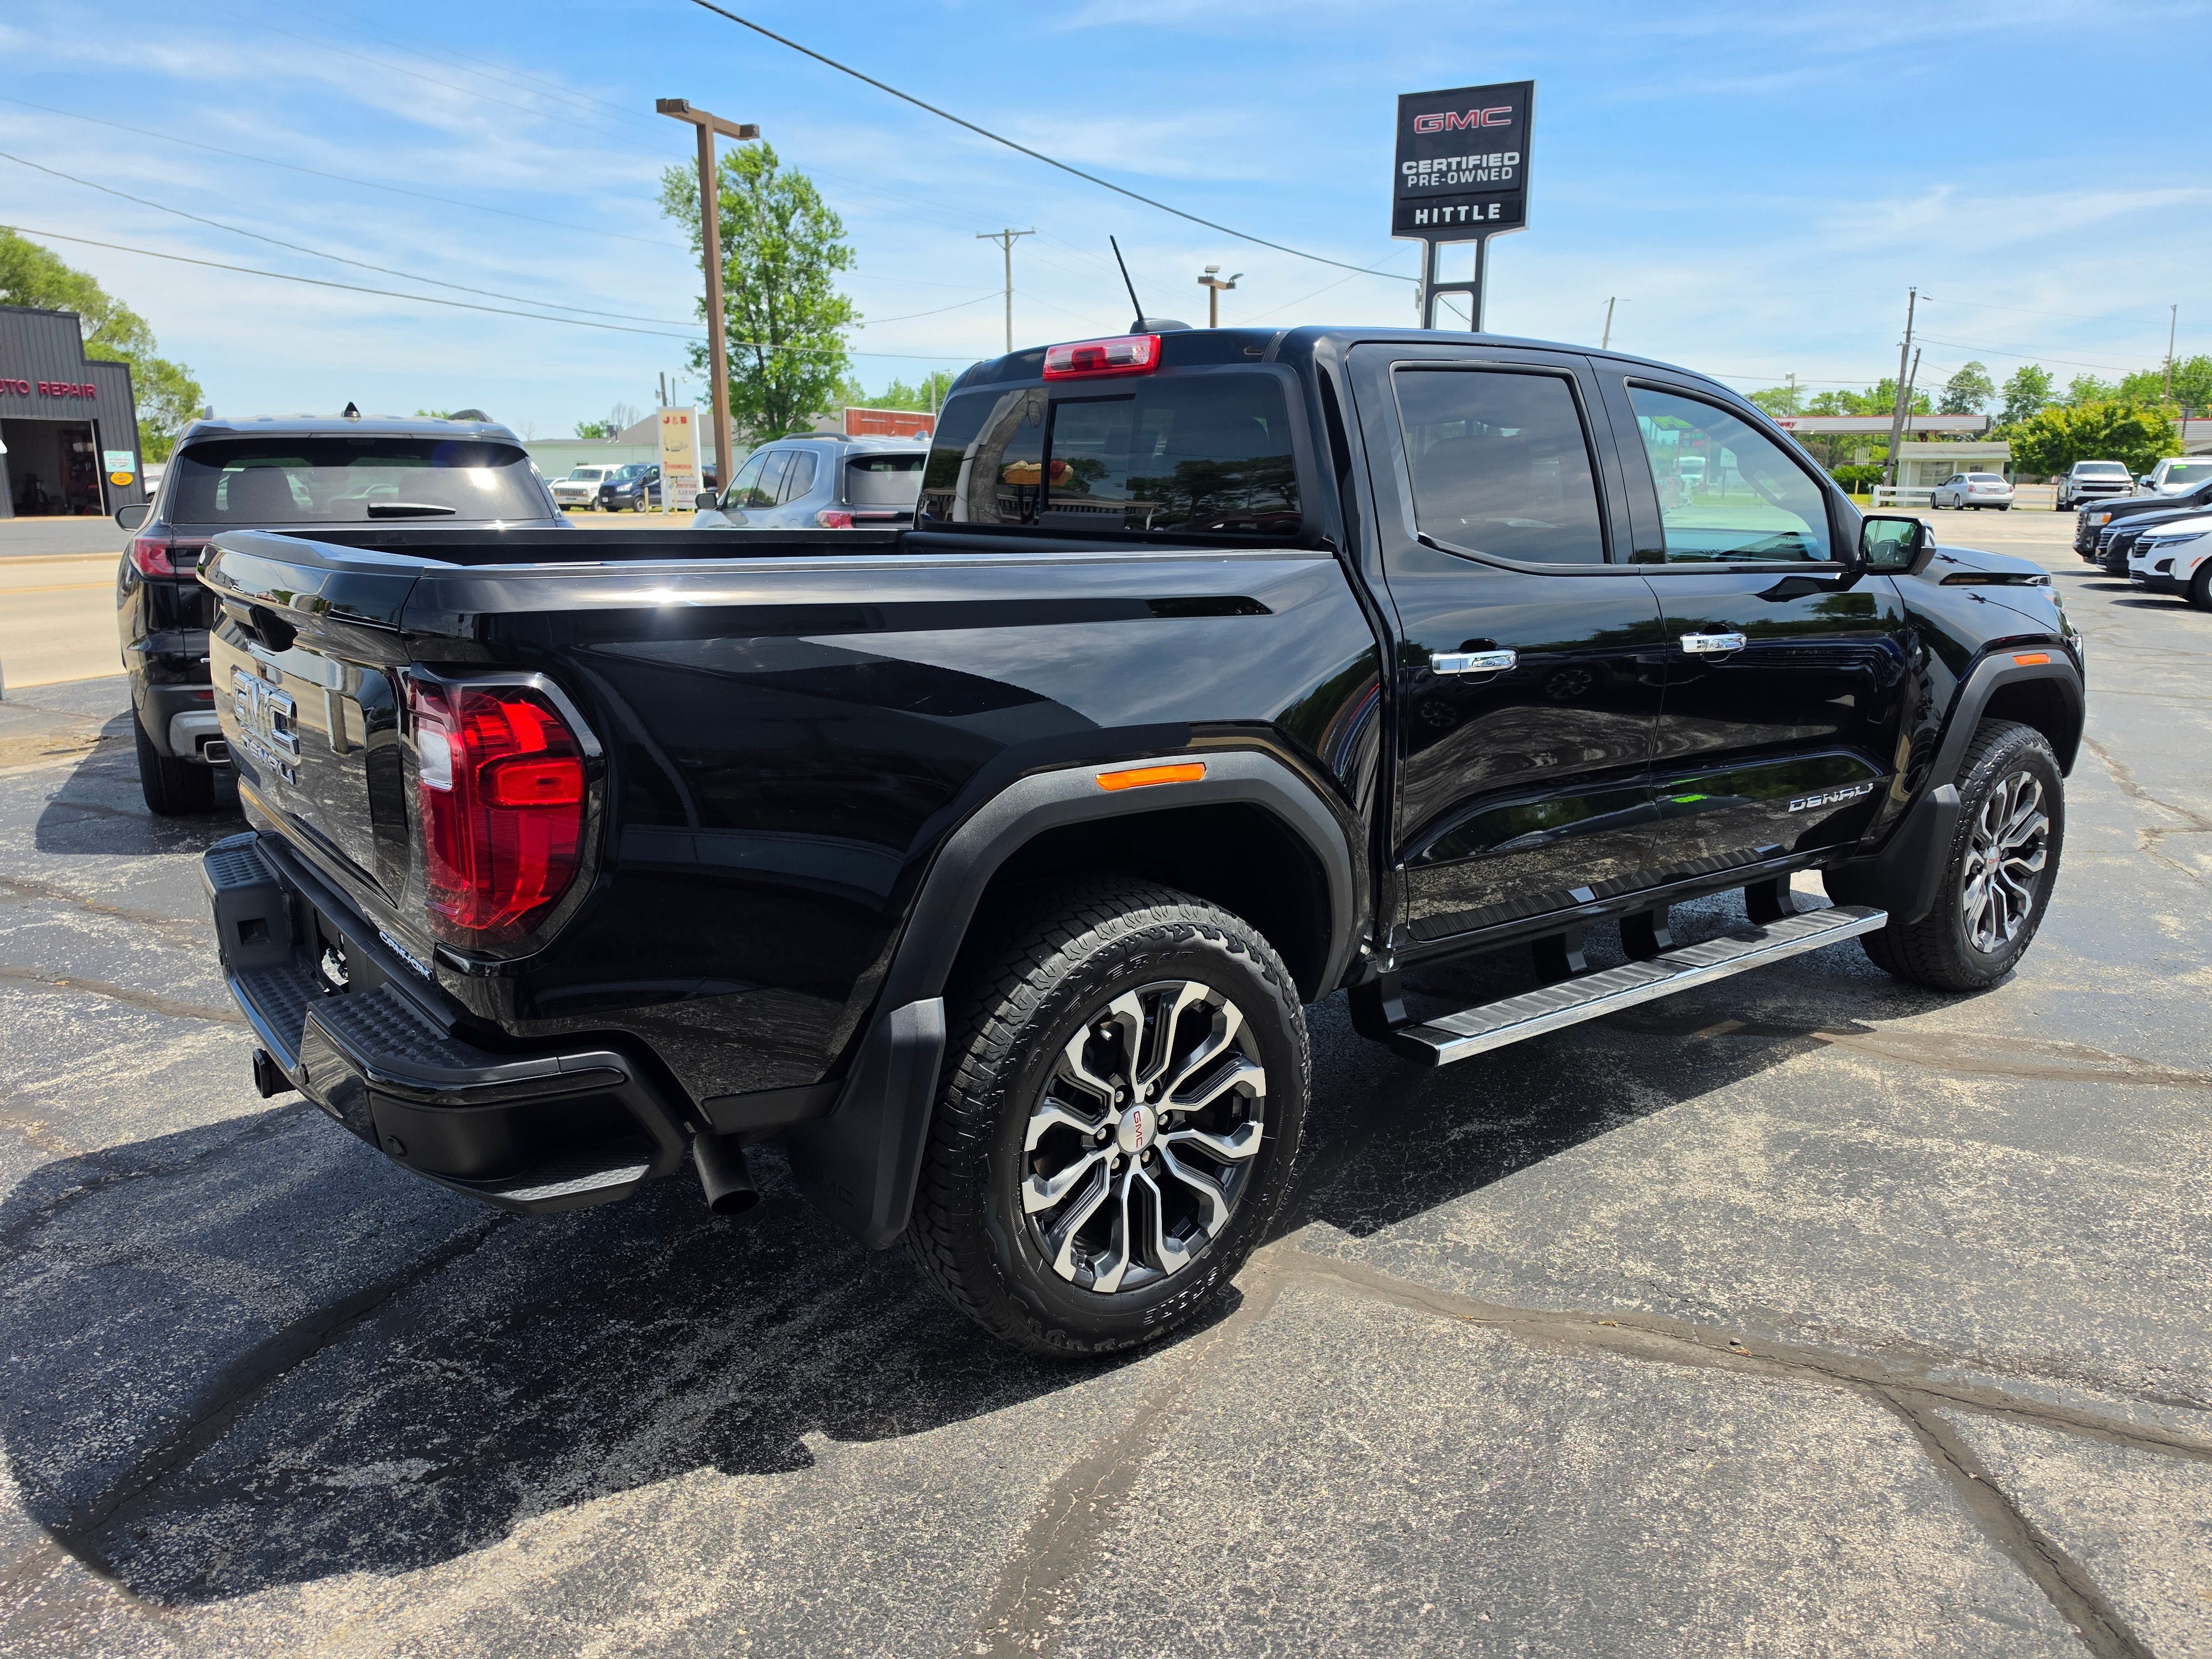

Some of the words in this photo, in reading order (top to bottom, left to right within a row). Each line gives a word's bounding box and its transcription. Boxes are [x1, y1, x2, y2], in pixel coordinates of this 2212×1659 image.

[1414, 106, 1512, 134] GMC
[1402, 152, 1520, 175] CERTIFIED
[1407, 167, 1512, 187] PRE-OWNED
[1415, 203, 1501, 225] HITTLE
[38, 380, 97, 399] REPAIR
[672, 416, 679, 425] &
[241, 734, 296, 785] DENALI
[1787, 782, 1874, 812] DENALI
[1133, 1110, 1142, 1149] GMC
